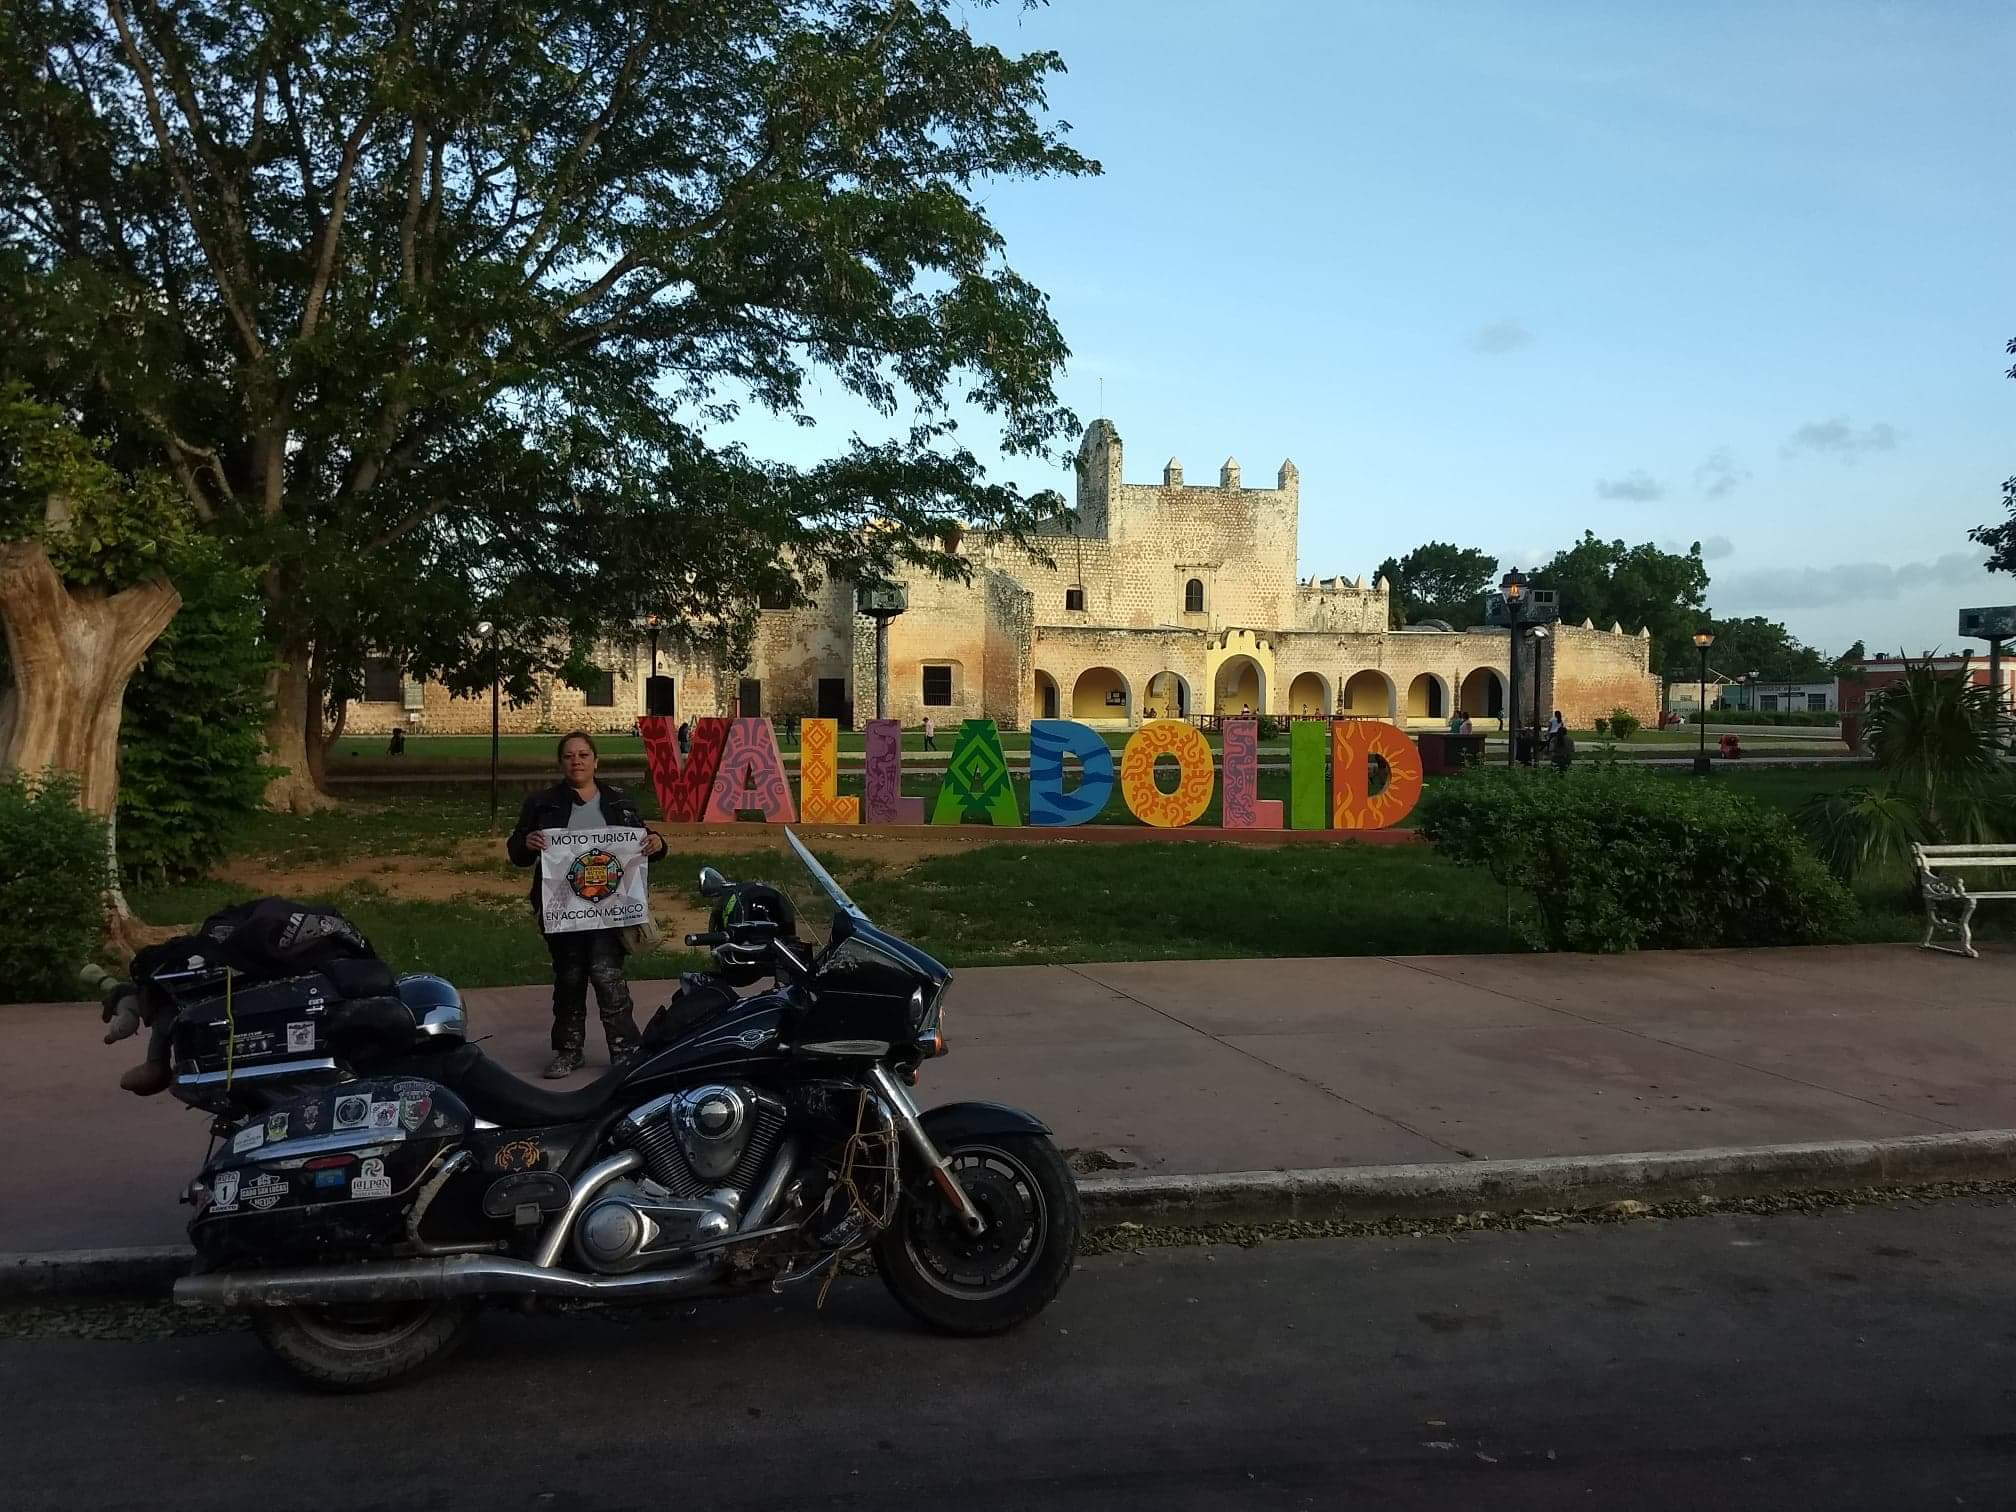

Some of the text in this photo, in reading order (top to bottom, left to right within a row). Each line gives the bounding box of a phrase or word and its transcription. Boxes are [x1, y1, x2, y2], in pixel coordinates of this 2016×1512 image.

[639, 715, 1424, 830] VALLADOLID
[551, 832, 638, 845] MOTO TURISTA
[546, 911, 559, 920] EN
[561, 907, 602, 920] ACCIÓN
